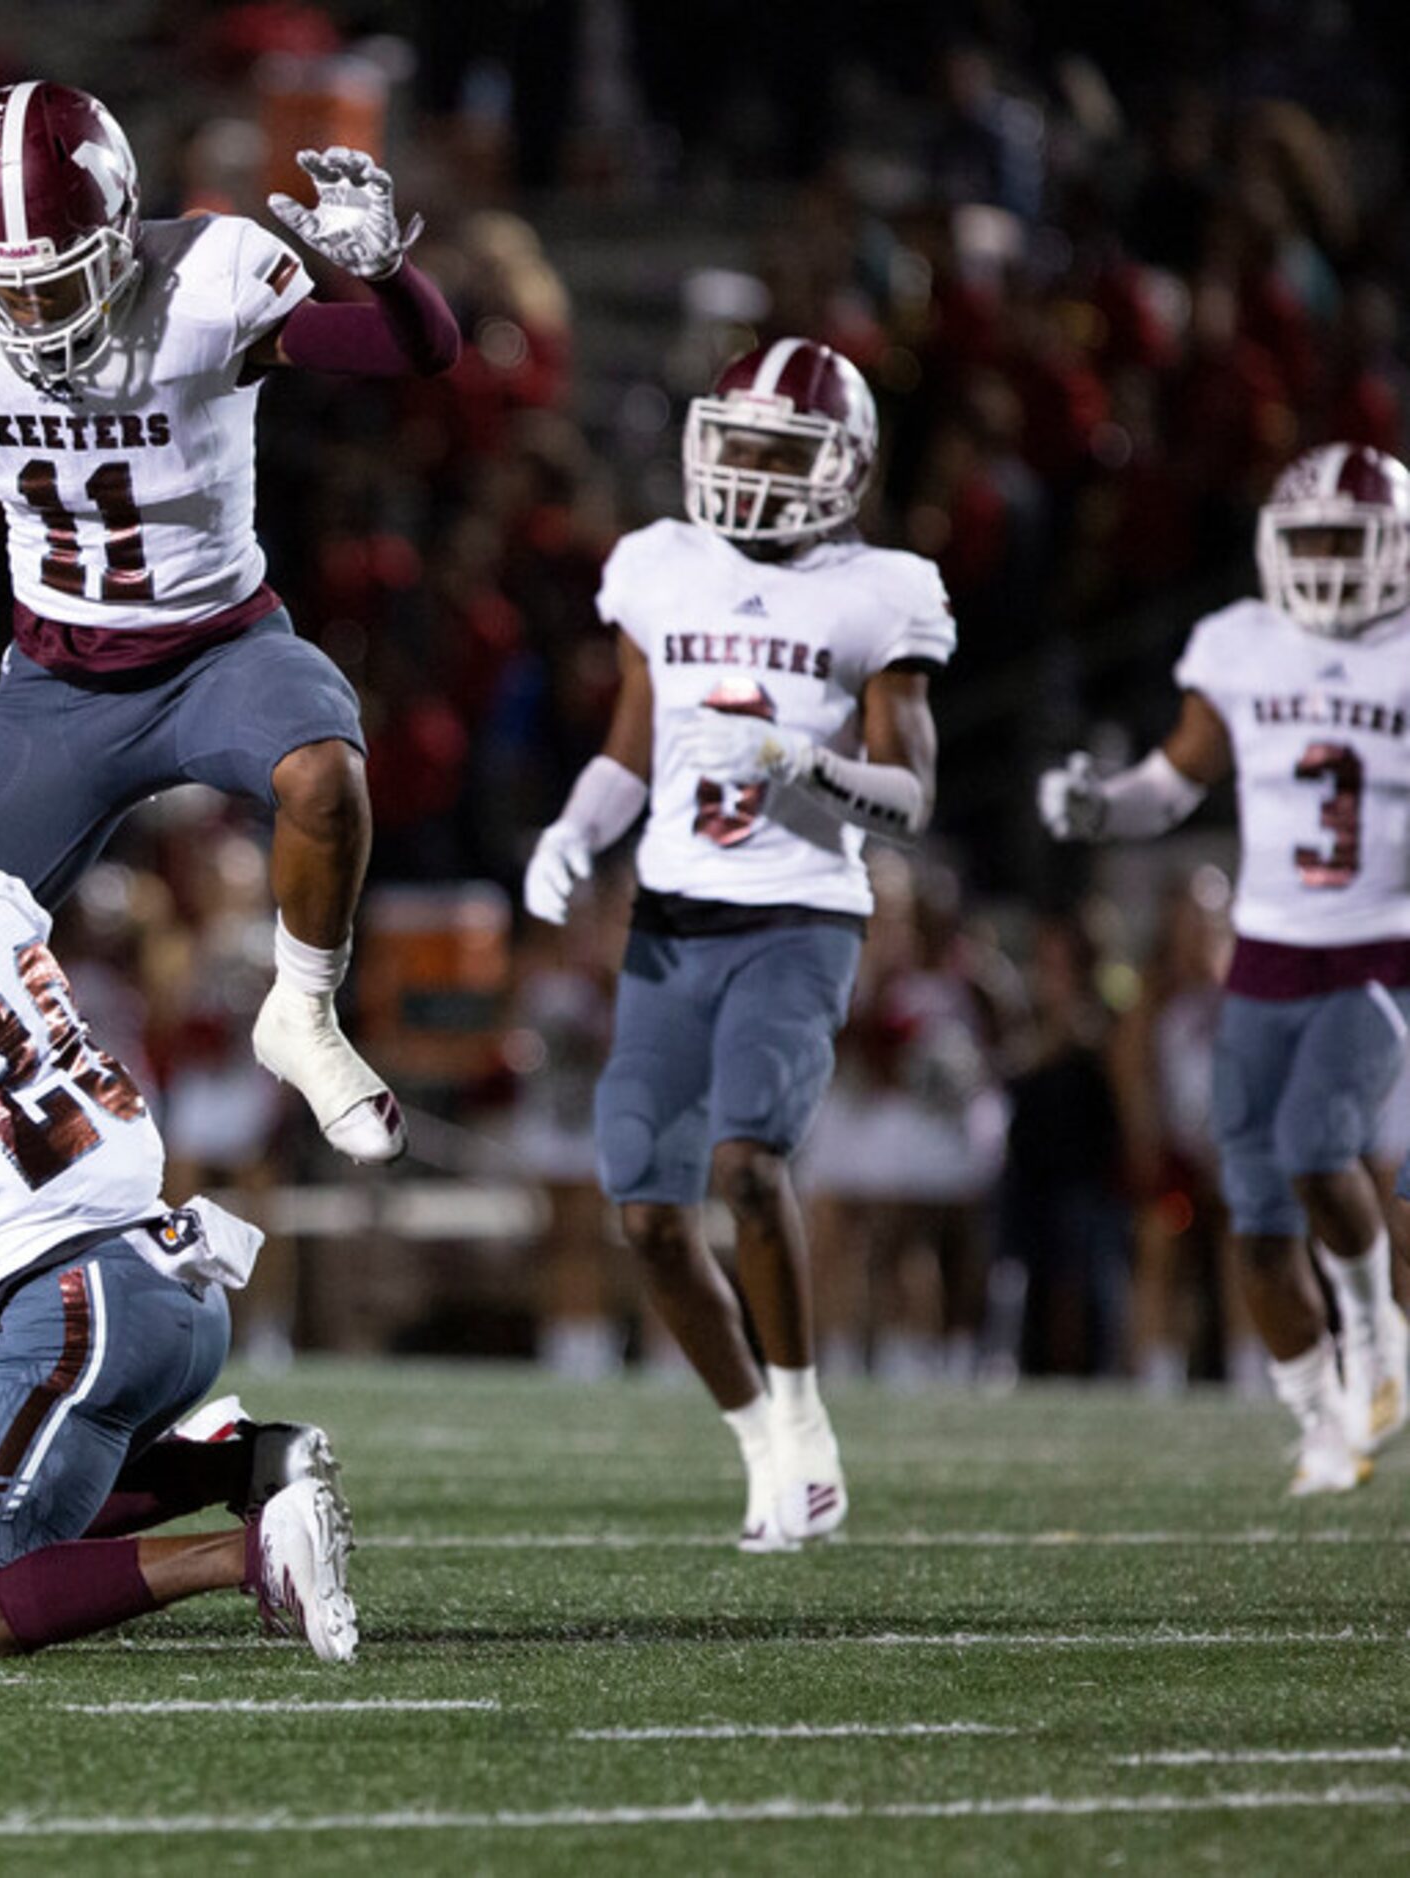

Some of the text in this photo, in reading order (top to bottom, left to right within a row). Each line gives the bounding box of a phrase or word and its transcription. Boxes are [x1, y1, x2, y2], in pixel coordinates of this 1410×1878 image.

[17, 459, 155, 602] 11
[664, 633, 832, 679] SKEETERS
[1295, 743, 1363, 887] 3
